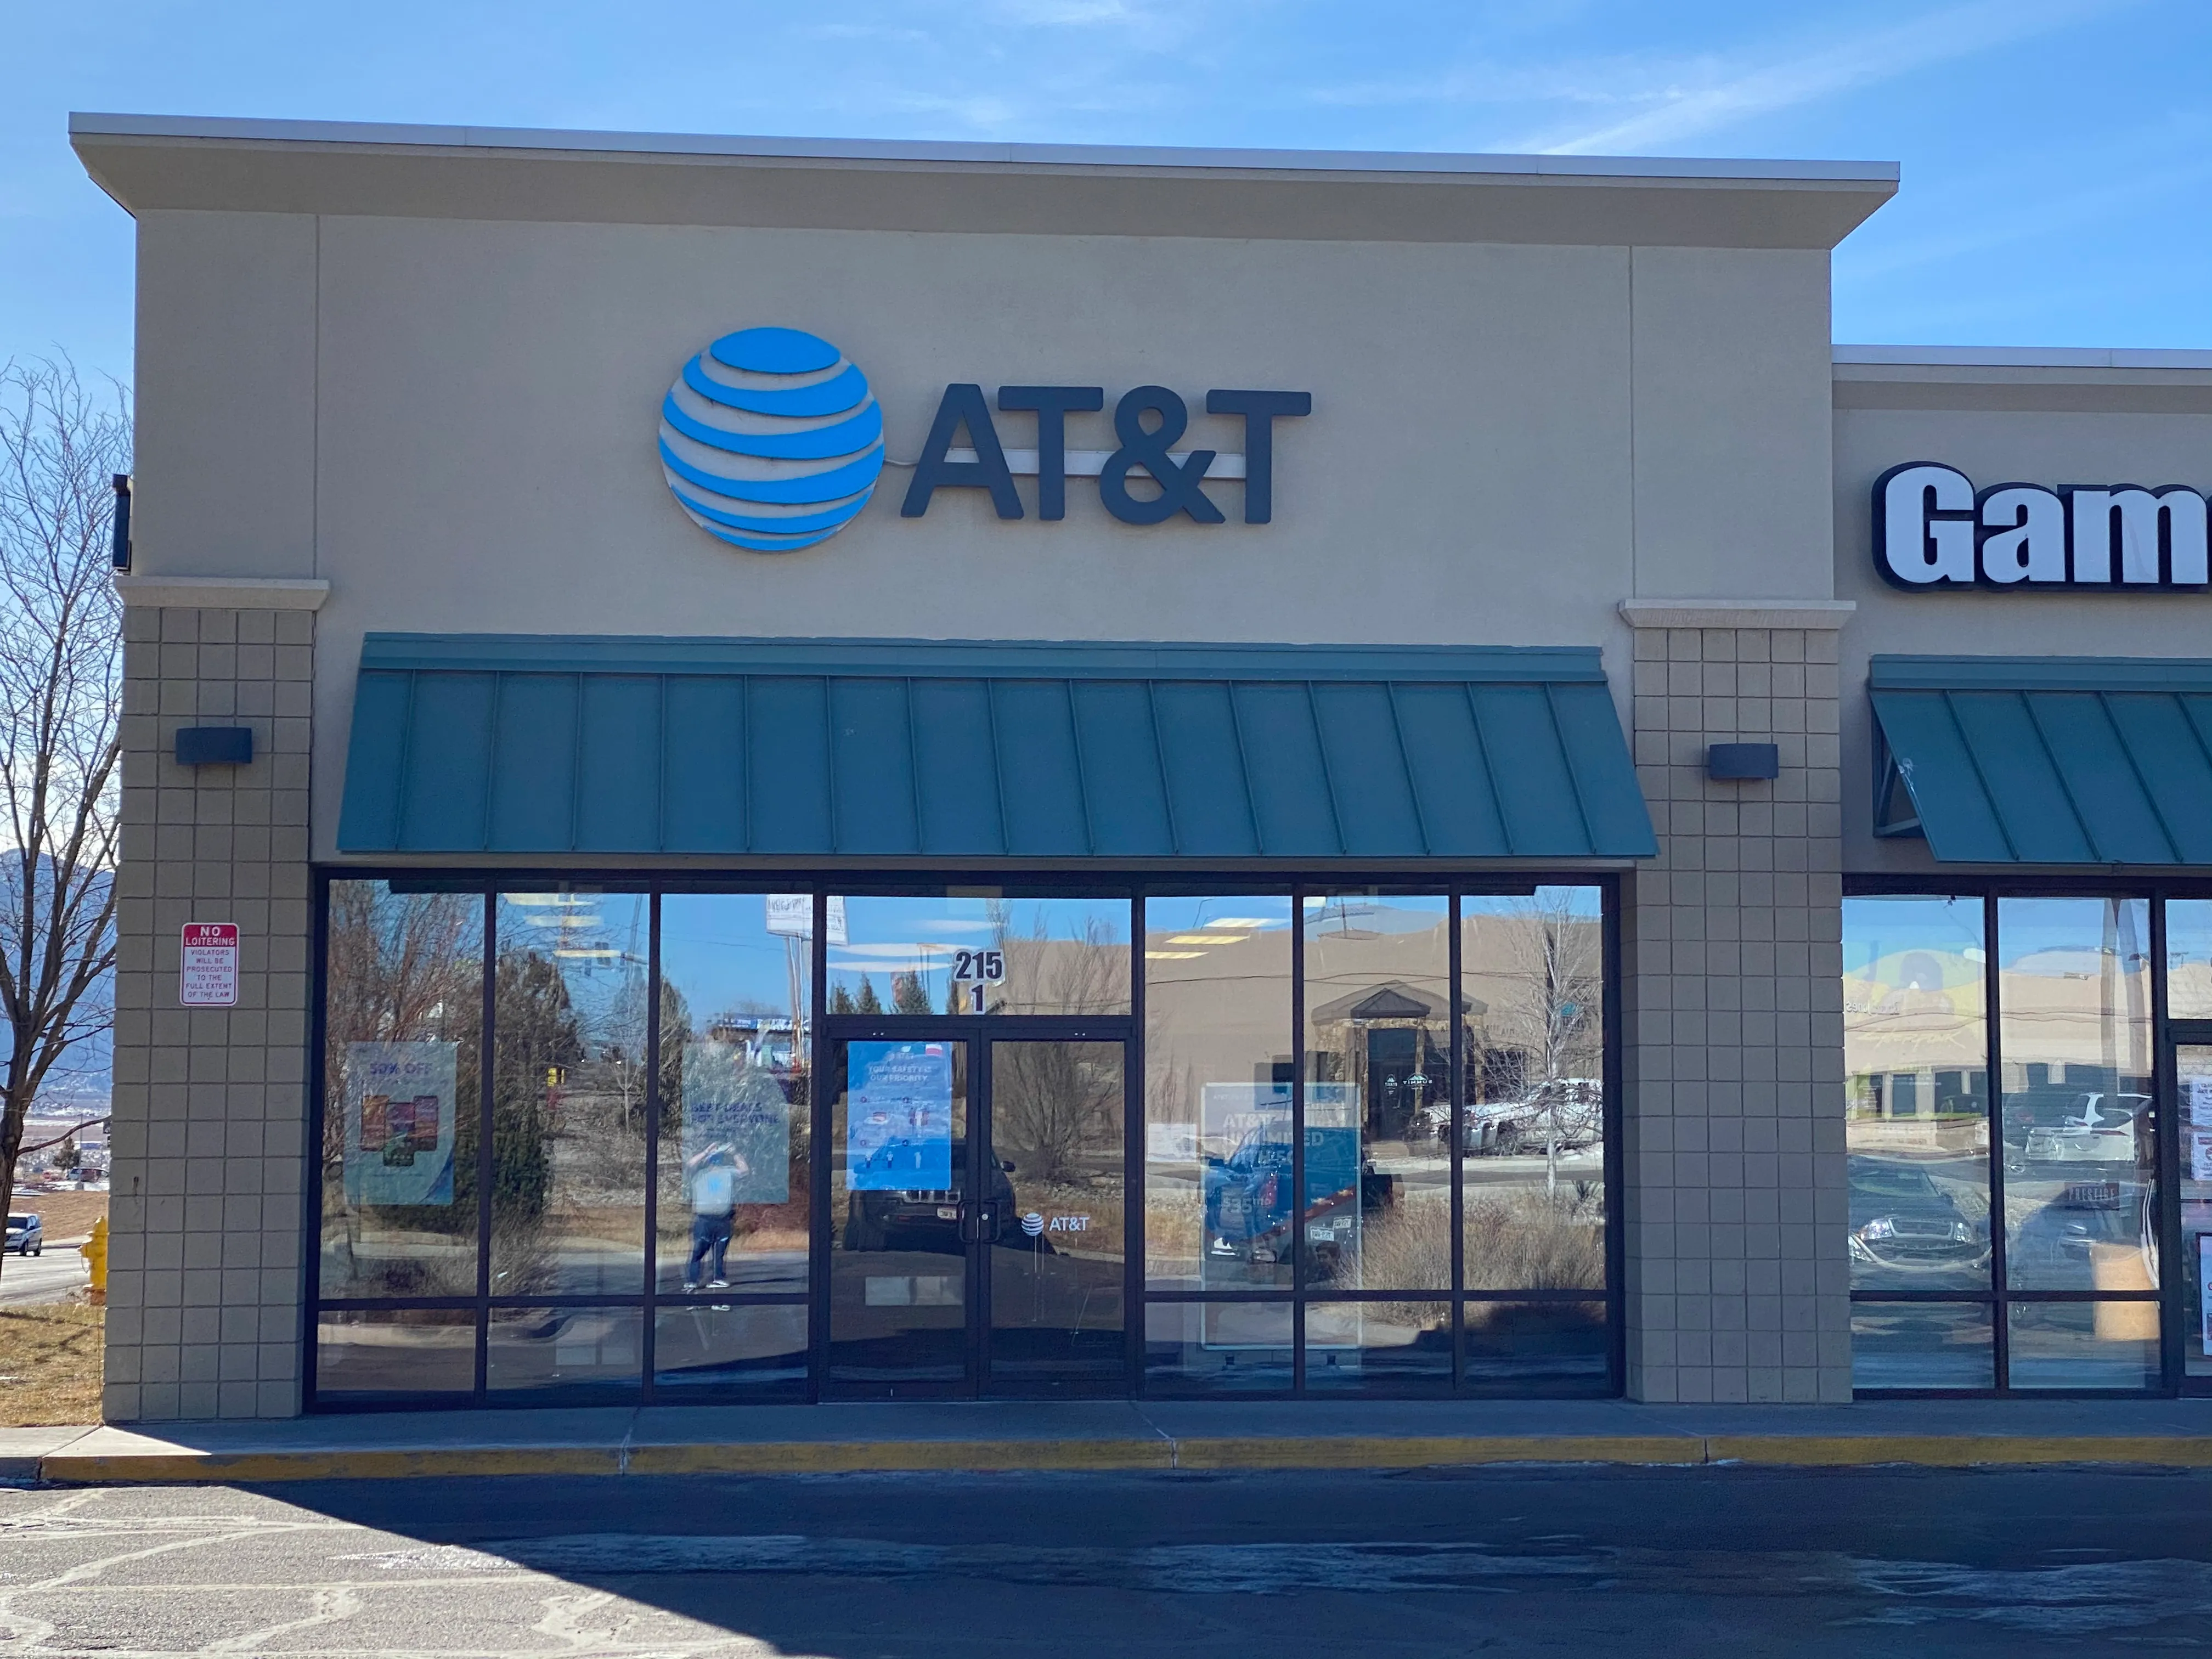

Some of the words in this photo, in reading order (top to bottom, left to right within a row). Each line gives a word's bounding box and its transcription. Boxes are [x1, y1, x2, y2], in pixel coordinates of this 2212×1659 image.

[901, 383, 1312, 525] AT&T
[1871, 461, 2212, 593] Gam
[185, 937, 235, 945] LOITERING
[200, 926, 220, 936] NO
[956, 951, 1002, 979] 215
[971, 984, 983, 1012] 1
[2068, 1187, 2115, 1202] PRESTIGE
[1048, 1216, 1090, 1232] AT&T
